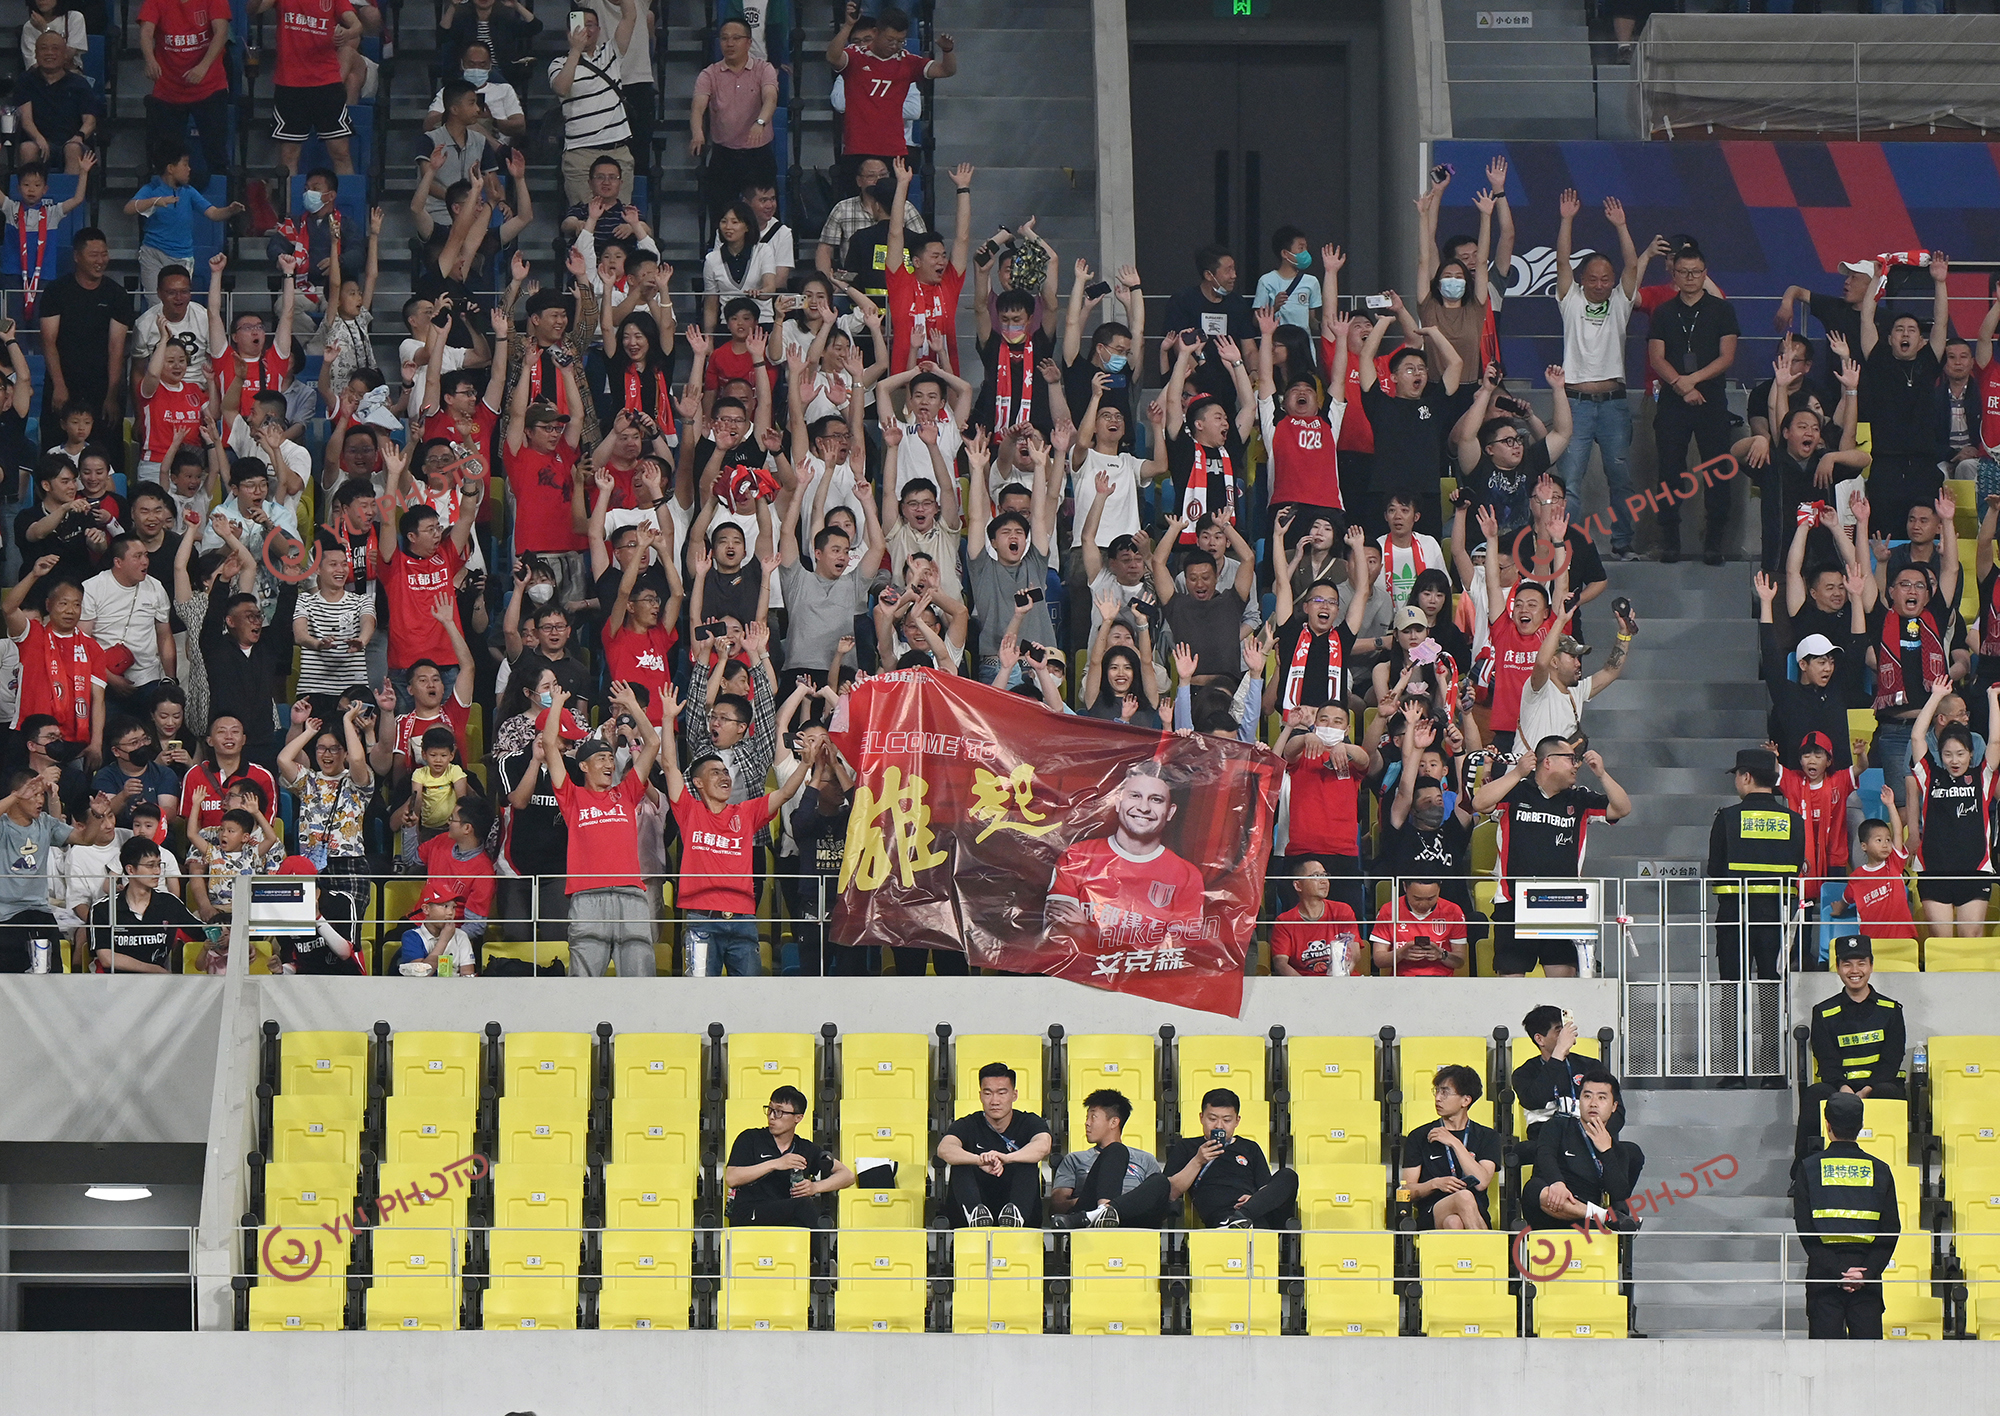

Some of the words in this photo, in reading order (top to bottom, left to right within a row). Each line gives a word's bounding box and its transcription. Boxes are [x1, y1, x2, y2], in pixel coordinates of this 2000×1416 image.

[284, 12, 329, 30] 成都建工
[1495, 16, 1530, 25] 小心台阶
[164, 31, 209, 47] 成都建工
[870, 79, 892, 97] 77
[1298, 430, 1322, 450] 028
[1504, 649, 1538, 665] 成都建
[860, 730, 958, 757] ELCOME
[963, 737, 999, 761] TO
[578, 804, 627, 822] 成都建工
[1742, 817, 1789, 832] 捷特保安
[692, 831, 743, 850] 成都建工
[816, 849, 845, 862] MESS
[1659, 867, 1698, 877] 小心台阶
[1091, 947, 1187, 977] 艾克森
[1842, 1032, 1880, 1045] 捷特保安
[1823, 1164, 1872, 1179] 捷特保安
